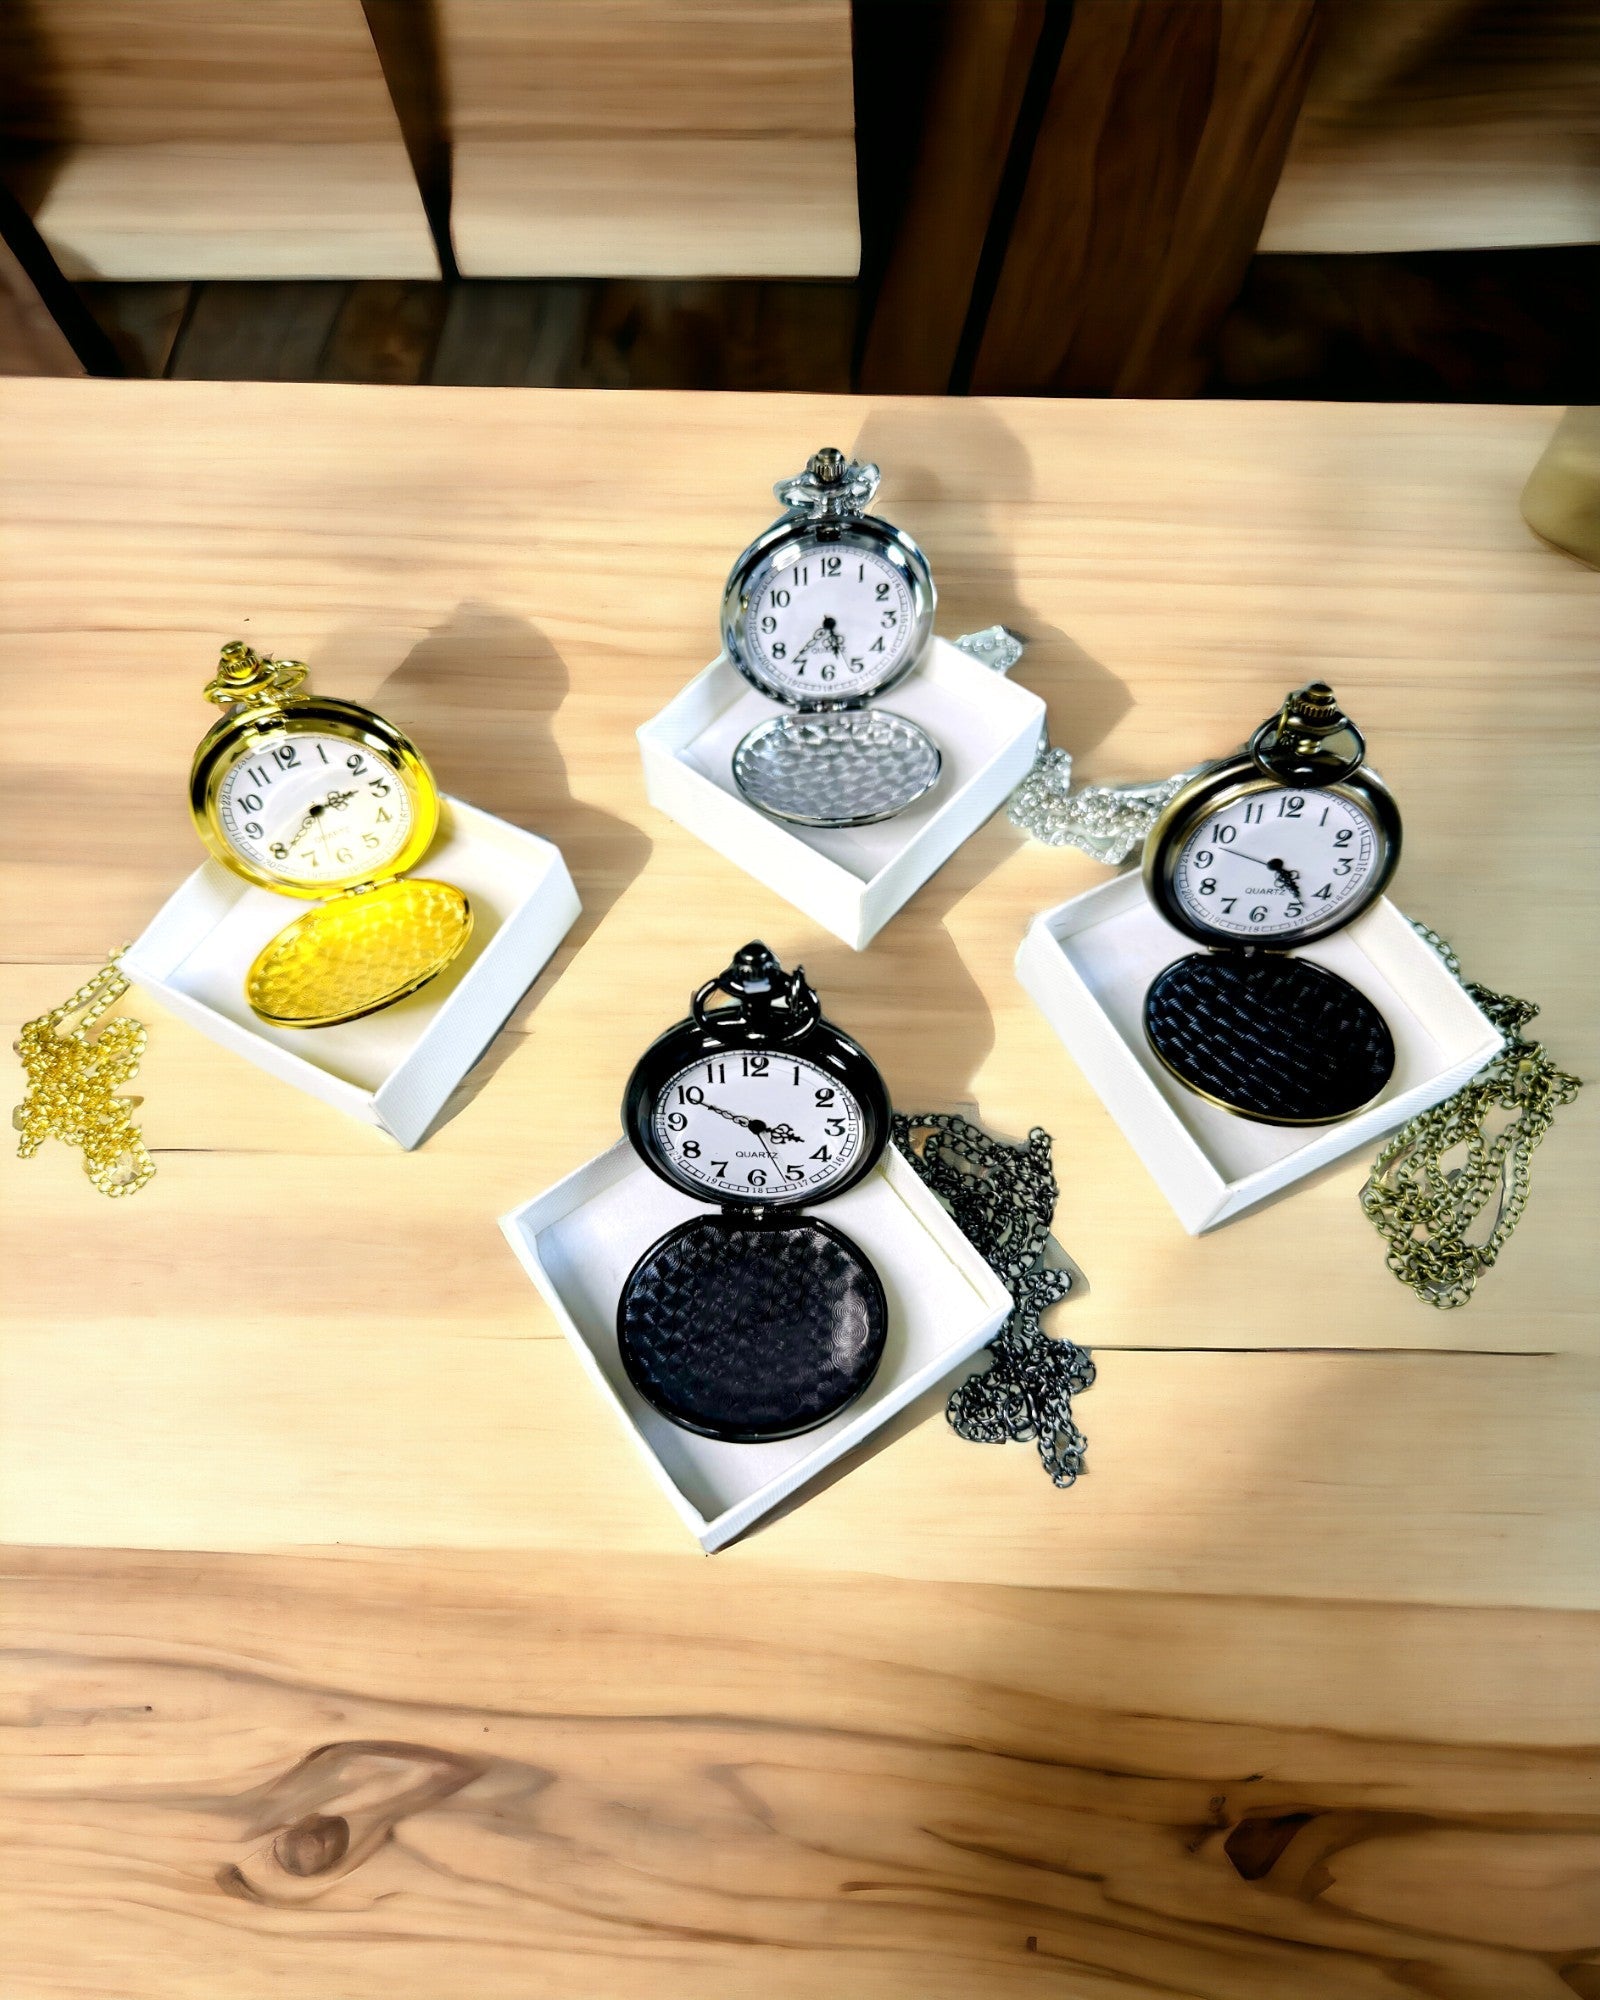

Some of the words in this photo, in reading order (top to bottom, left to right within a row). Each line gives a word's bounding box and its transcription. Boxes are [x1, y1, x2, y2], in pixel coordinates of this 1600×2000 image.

[820, 556, 842, 577] 12
[858, 563, 864, 583] 1
[793, 566, 808, 586] 11
[770, 589, 790, 608] 10
[875, 583, 890, 602] 2
[761, 616, 777, 634] 9
[881, 610, 896, 629] 3
[772, 642, 786, 660] 8
[868, 636, 886, 654] 4
[793, 658, 808, 676] 7
[821, 664, 836, 682] 6
[850, 657, 864, 674] 5
[272, 745, 302, 771] 12
[316, 743, 329, 764] 1
[346, 754, 368, 776] 2
[247, 765, 272, 788] 11
[368, 777, 391, 798] 3
[237, 794, 264, 814] 10
[1244, 802, 1264, 824] 11
[1277, 796, 1305, 818] 12
[375, 806, 392, 824] 4
[1318, 806, 1329, 826] 1
[245, 822, 264, 840] 9
[1211, 823, 1236, 844] 10
[1332, 829, 1353, 848] 2
[362, 832, 380, 849] 5
[269, 842, 289, 860] 8
[301, 850, 319, 868] 7
[336, 847, 353, 864] 6
[1193, 850, 1214, 869] 9
[1333, 858, 1354, 876] 3
[1198, 877, 1216, 896] 8
[1245, 887, 1286, 896] QUARTZ
[1310, 883, 1332, 900] 4
[1220, 897, 1238, 914] 7
[1249, 905, 1268, 923] 6
[1284, 901, 1304, 918] 5
[706, 1063, 726, 1084] 11
[742, 1056, 770, 1078] 12
[793, 1065, 800, 1086] 1
[677, 1085, 704, 1105] 10
[814, 1087, 835, 1108] 2
[667, 1112, 688, 1132] 9
[824, 1117, 846, 1137] 3
[682, 1140, 702, 1158] 8
[735, 1151, 778, 1159] QUARTZ
[808, 1144, 832, 1162] 4
[710, 1160, 728, 1178] 7
[832, 1155, 845, 1166] 16
[706, 1176, 718, 1184] 19
[747, 1168, 767, 1186] 6
[785, 1164, 804, 1180] 5
